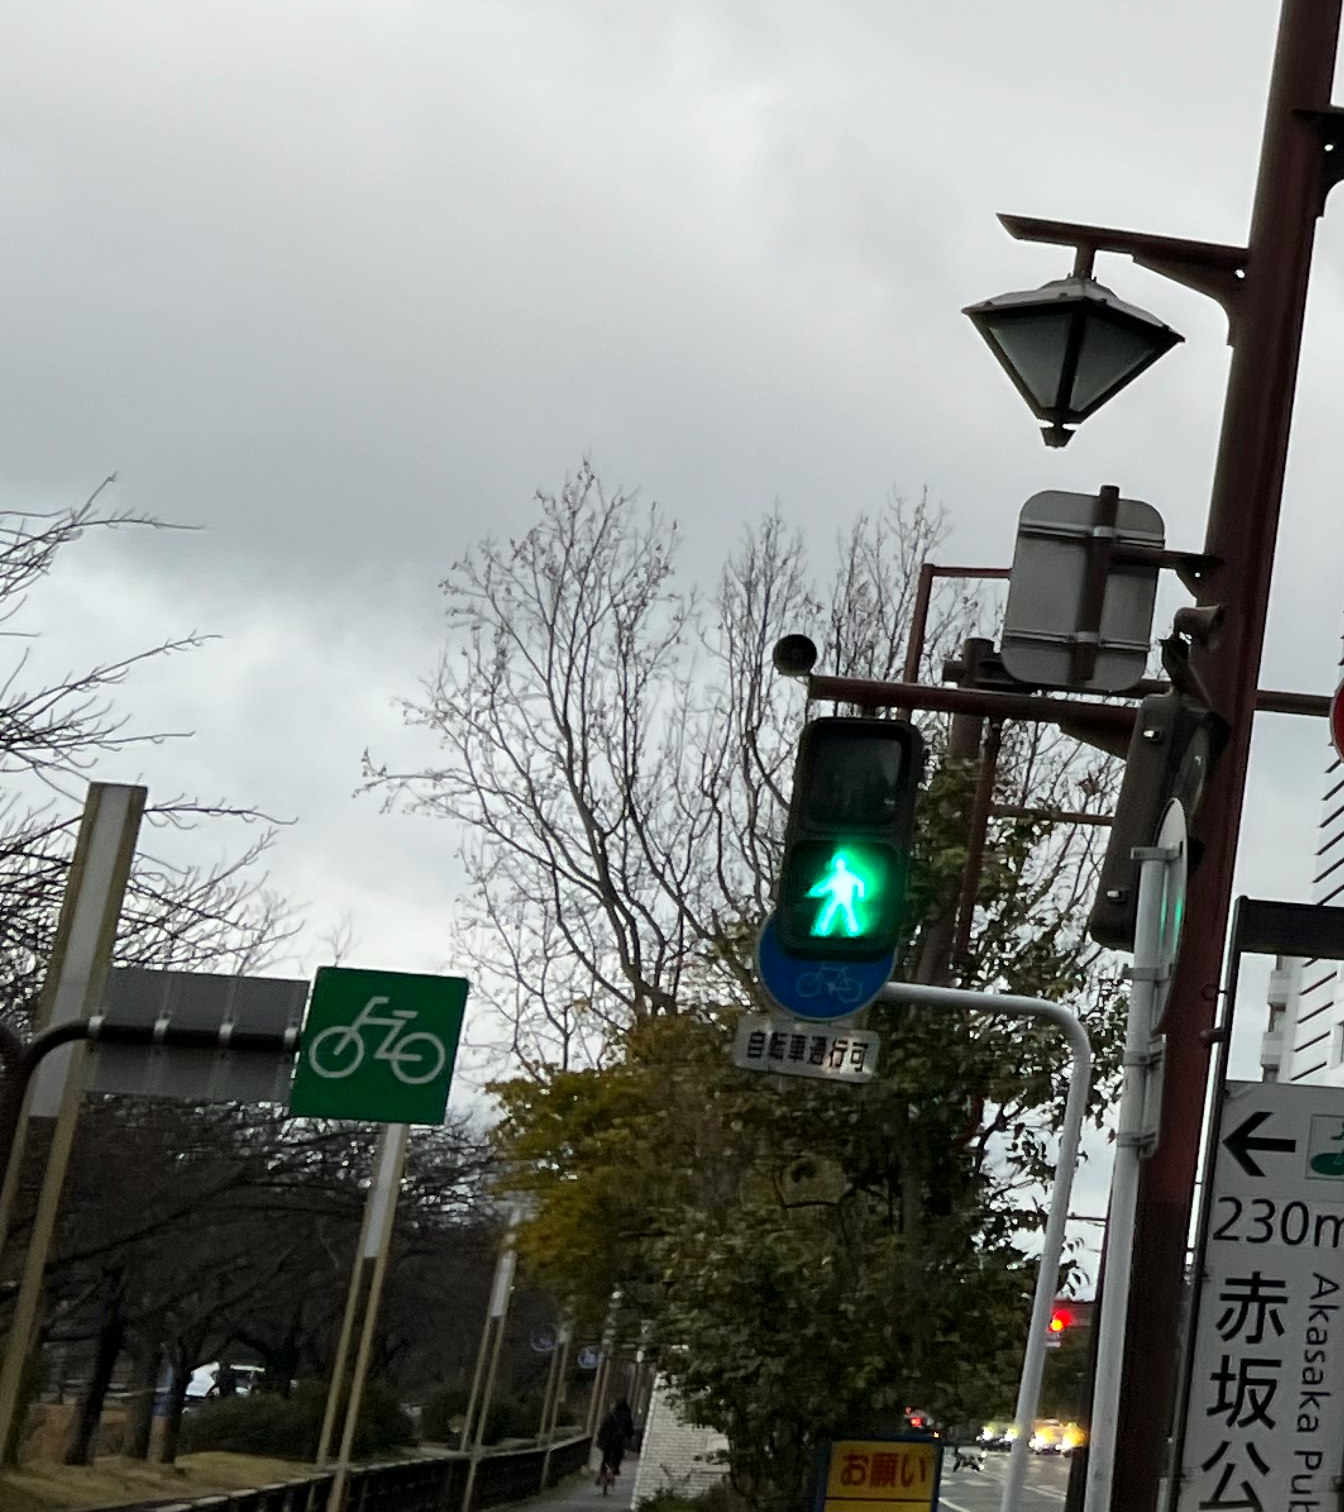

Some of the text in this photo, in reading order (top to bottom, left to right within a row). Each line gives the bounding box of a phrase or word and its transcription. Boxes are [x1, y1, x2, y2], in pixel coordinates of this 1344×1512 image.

[747, 1029, 869, 1073] 自転車通行可
[1199, 1271, 1288, 1512] 赤坂公
[1297, 1272, 1340, 1433] Akasaka
[840, 1452, 926, 1488] お願い
